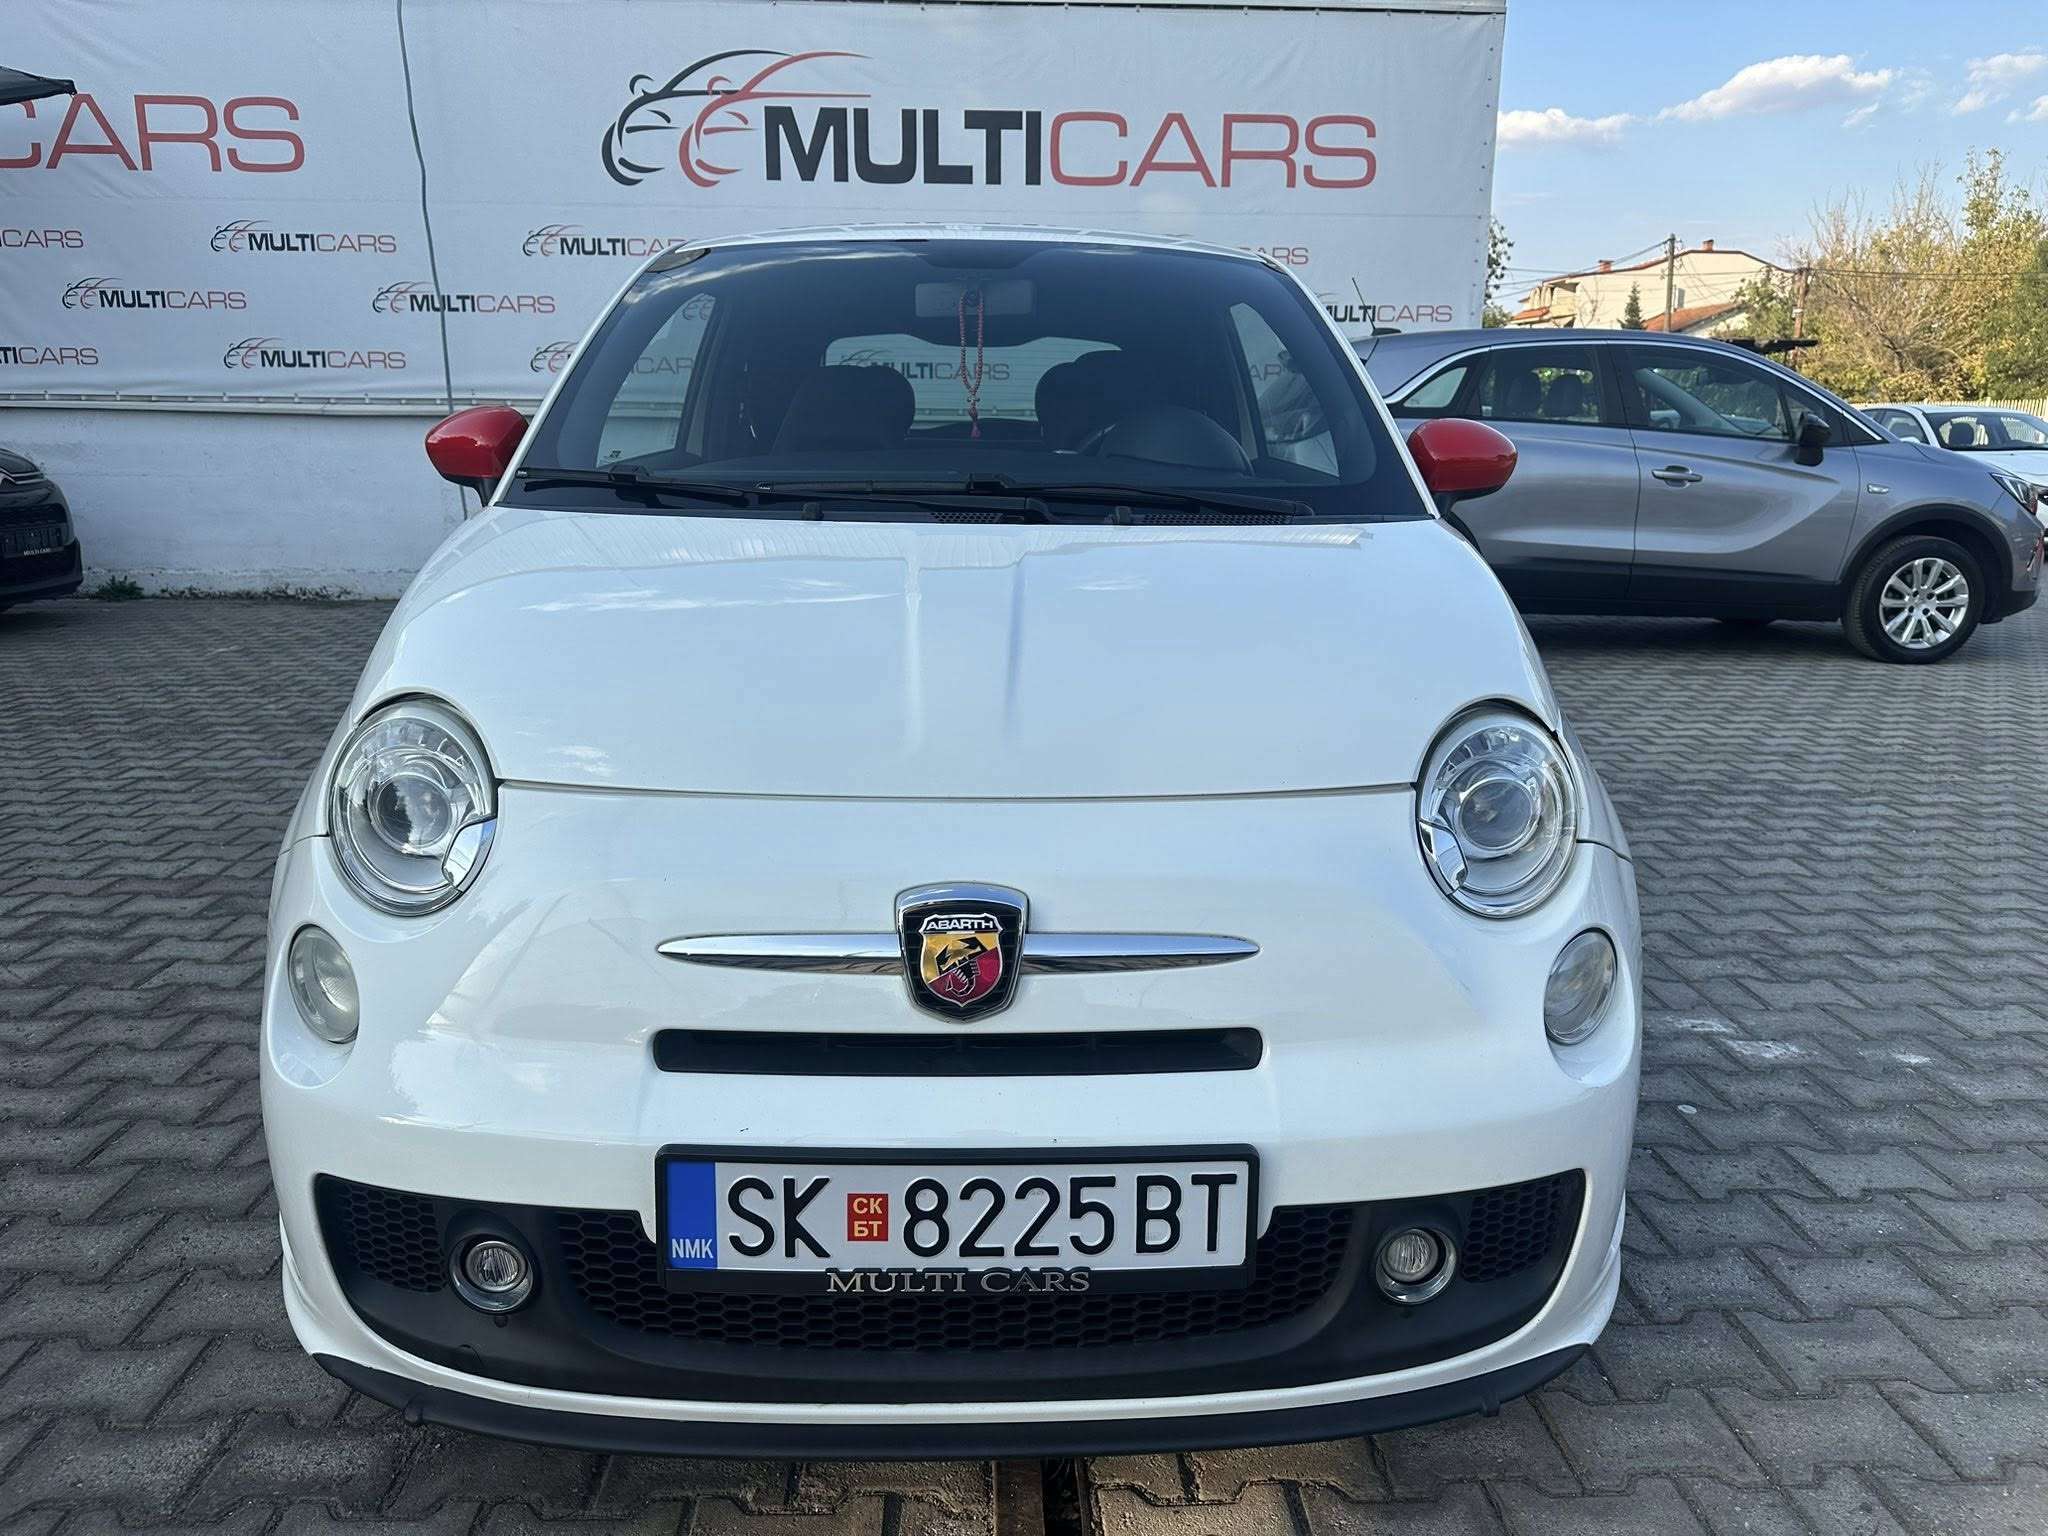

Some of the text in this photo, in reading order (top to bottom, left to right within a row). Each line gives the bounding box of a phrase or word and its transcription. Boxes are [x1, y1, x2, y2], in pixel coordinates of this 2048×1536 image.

[764, 105, 1377, 189] MULTICARS
[0, 229, 84, 248] CARS
[248, 232, 397, 252] MULTICARS
[99, 290, 247, 309] MULTICARS
[409, 294, 555, 313] MULTICARS
[0, 346, 98, 365] TICARS
[260, 350, 406, 369] MULTICARS
[925, 918, 994, 930] ABARTH
[727, 1176, 831, 1258] SK
[671, 1238, 715, 1260] NMK
[825, 1270, 1091, 1293] MULTI CARS
